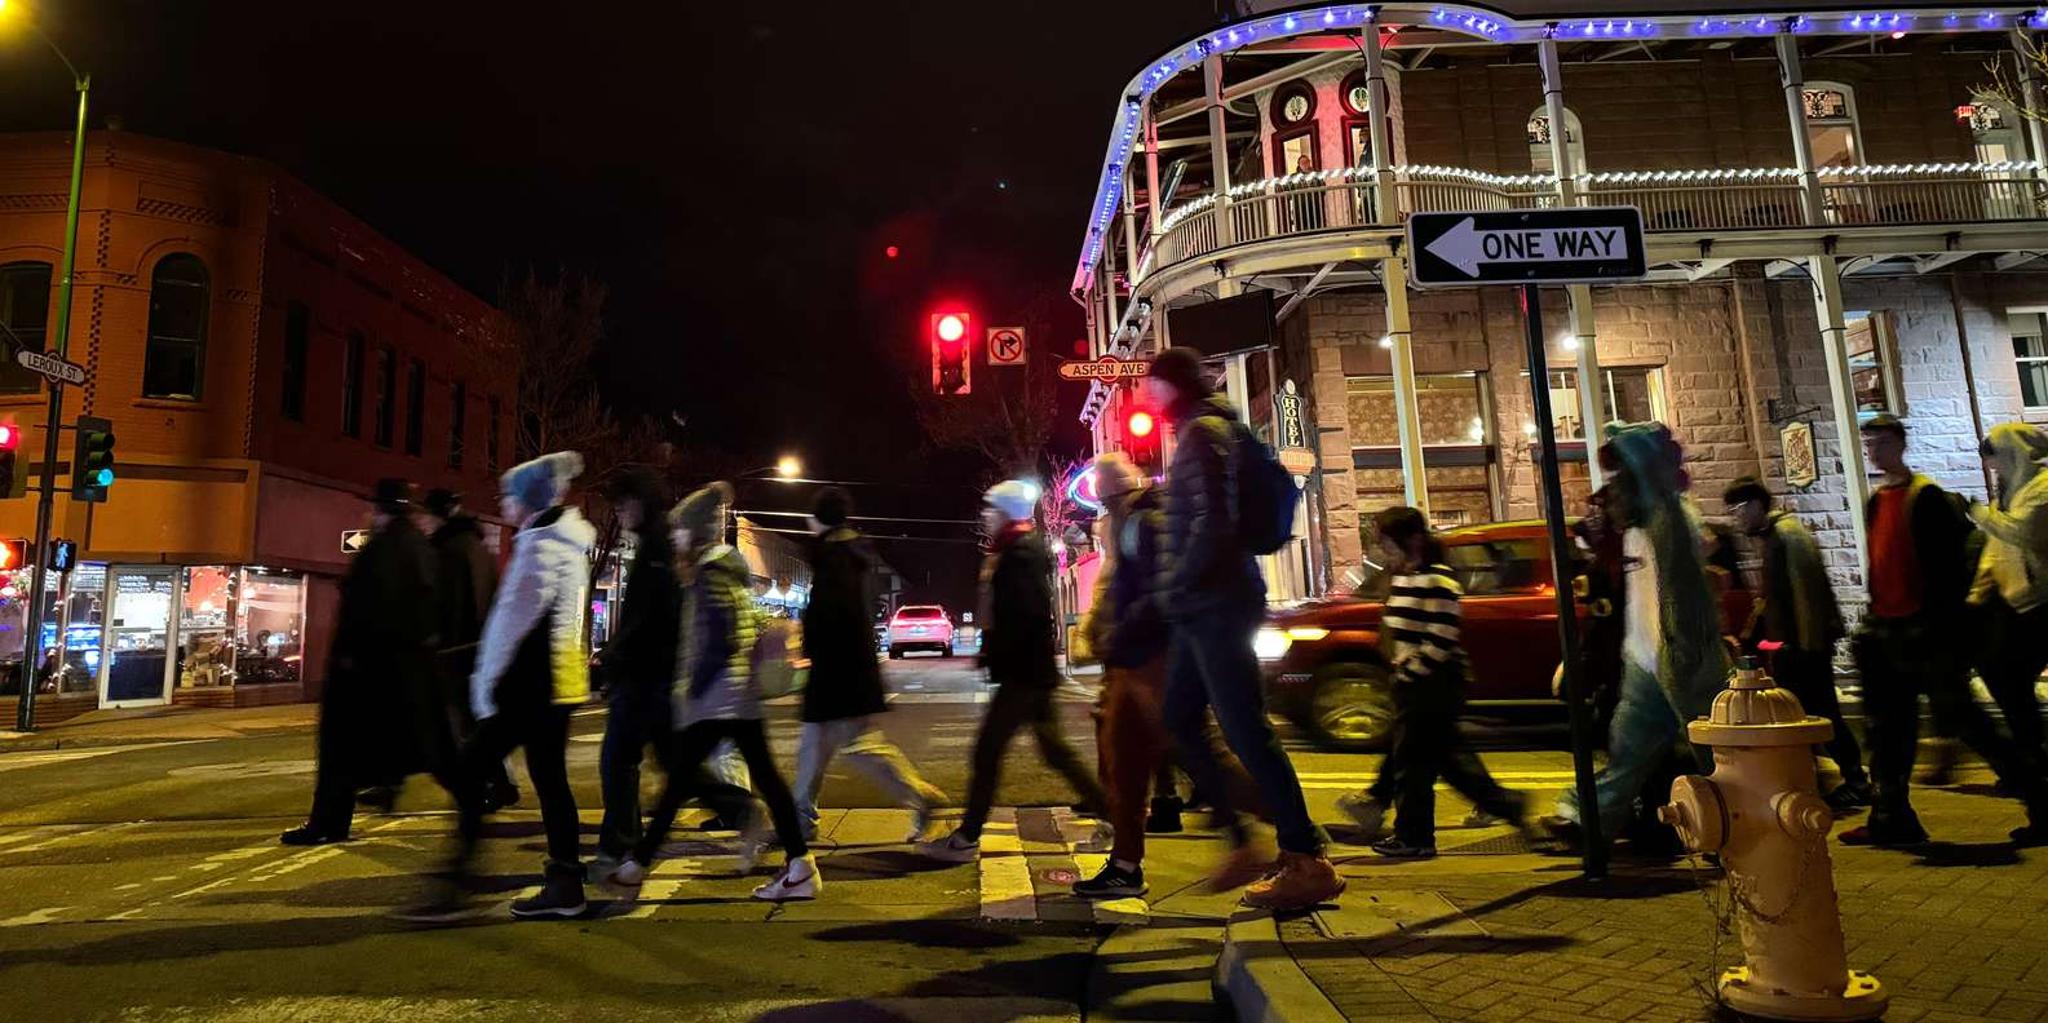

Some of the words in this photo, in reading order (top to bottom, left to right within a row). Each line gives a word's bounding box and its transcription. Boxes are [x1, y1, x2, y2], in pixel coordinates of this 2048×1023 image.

[1483, 233, 1544, 260] ONE
[1554, 230, 1616, 257] WAY
[28, 354, 64, 376] LEROUX
[67, 367, 78, 380] ST
[1073, 364, 1115, 375] ASPEN
[1120, 363, 1145, 374] AVE
[1284, 398, 1300, 446] HOTEL
